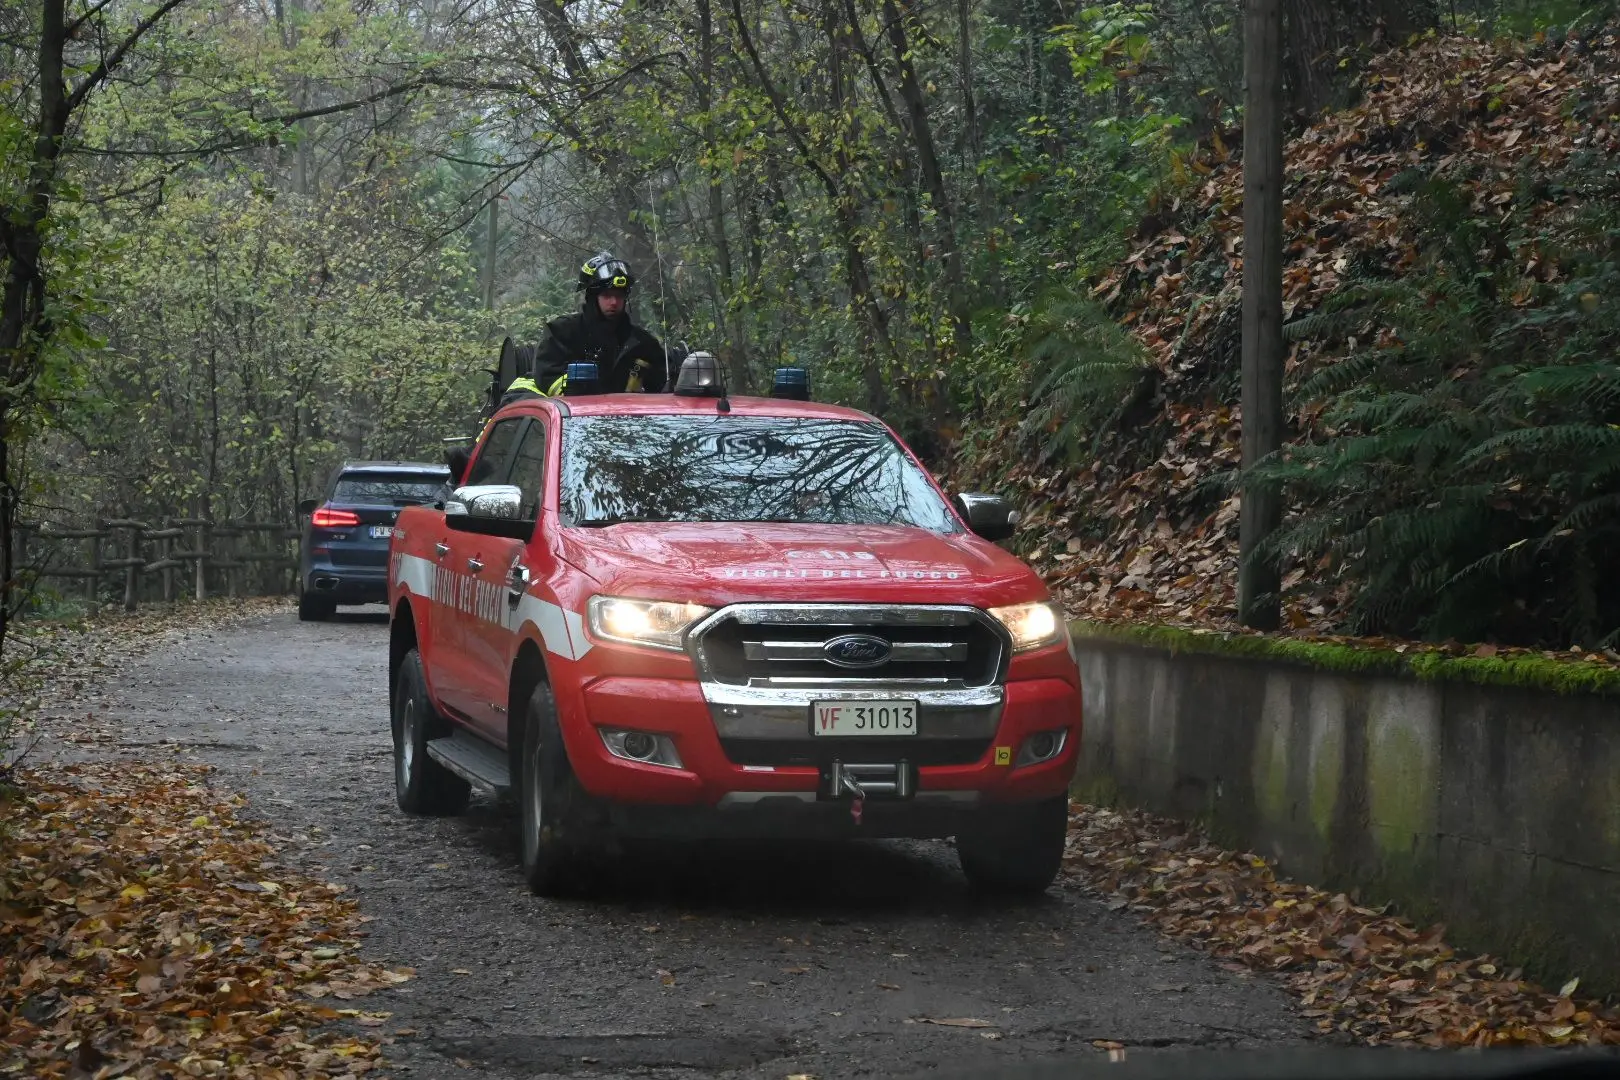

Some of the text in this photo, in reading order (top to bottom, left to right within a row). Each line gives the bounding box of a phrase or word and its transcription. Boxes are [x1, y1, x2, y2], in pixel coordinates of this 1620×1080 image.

[724, 568, 959, 579] VIGILI DEL FUOCO
[459, 574, 474, 614] DEL
[474, 579, 502, 624] FUOCO
[841, 642, 877, 657] Ford
[819, 707, 913, 730] VF 31013
